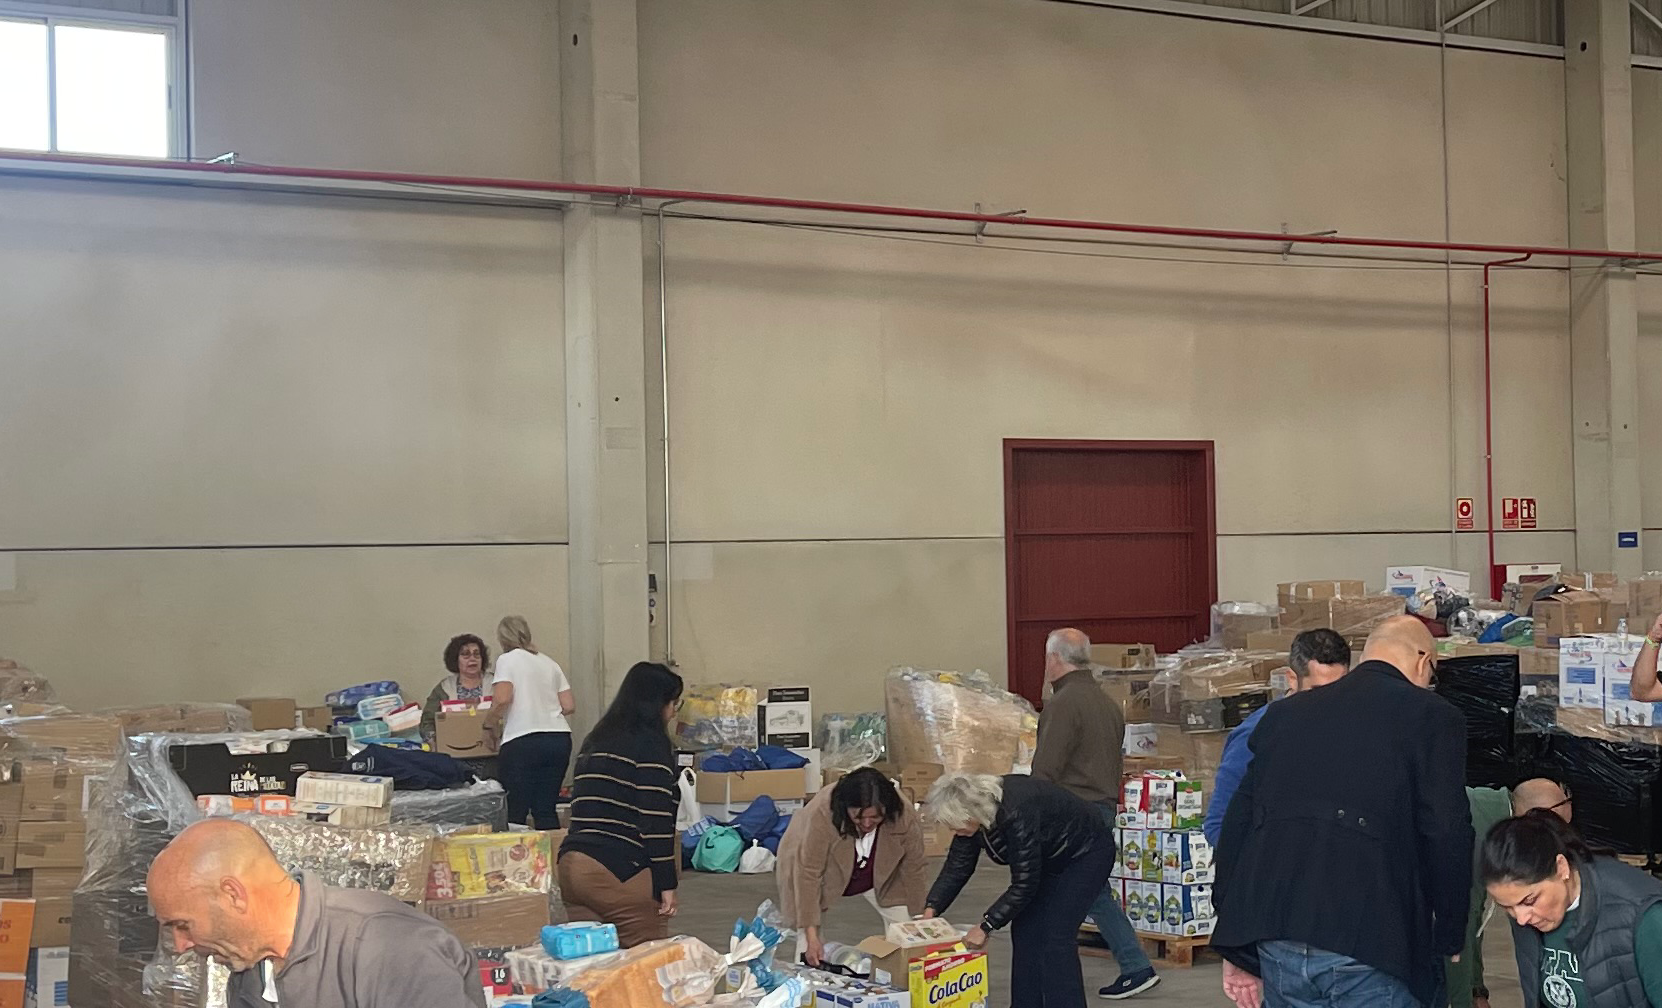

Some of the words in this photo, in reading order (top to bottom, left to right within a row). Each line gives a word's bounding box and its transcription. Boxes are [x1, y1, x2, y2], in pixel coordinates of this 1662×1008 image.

[231, 779, 259, 793] REINA
[494, 968, 506, 980] 16
[929, 972, 983, 1004] ColaCao
